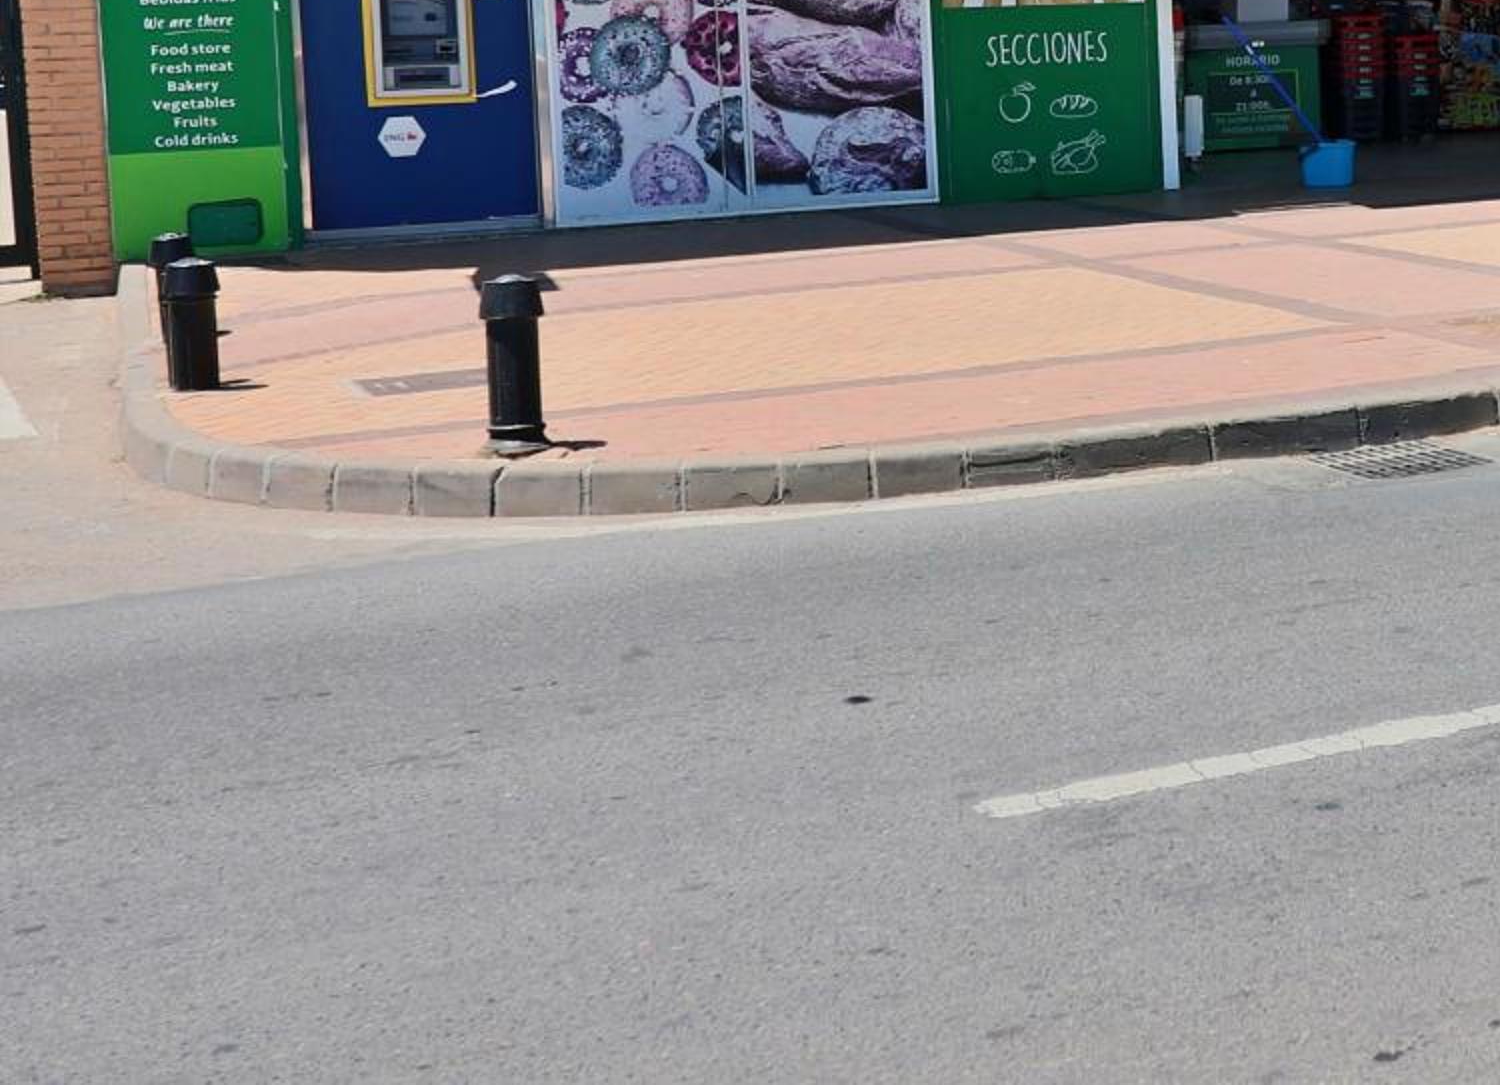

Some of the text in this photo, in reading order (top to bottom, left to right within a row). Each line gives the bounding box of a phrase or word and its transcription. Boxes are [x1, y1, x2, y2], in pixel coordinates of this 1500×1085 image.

[143, 14, 234, 30] We are there
[151, 43, 231, 56] Food store
[986, 30, 1108, 67] SECCIONES
[151, 61, 234, 75] Fresh meat
[167, 80, 219, 93] Bakery
[152, 97, 236, 114] Vegetables
[173, 115, 218, 128] Fruits
[154, 133, 239, 147] Cold drinks
